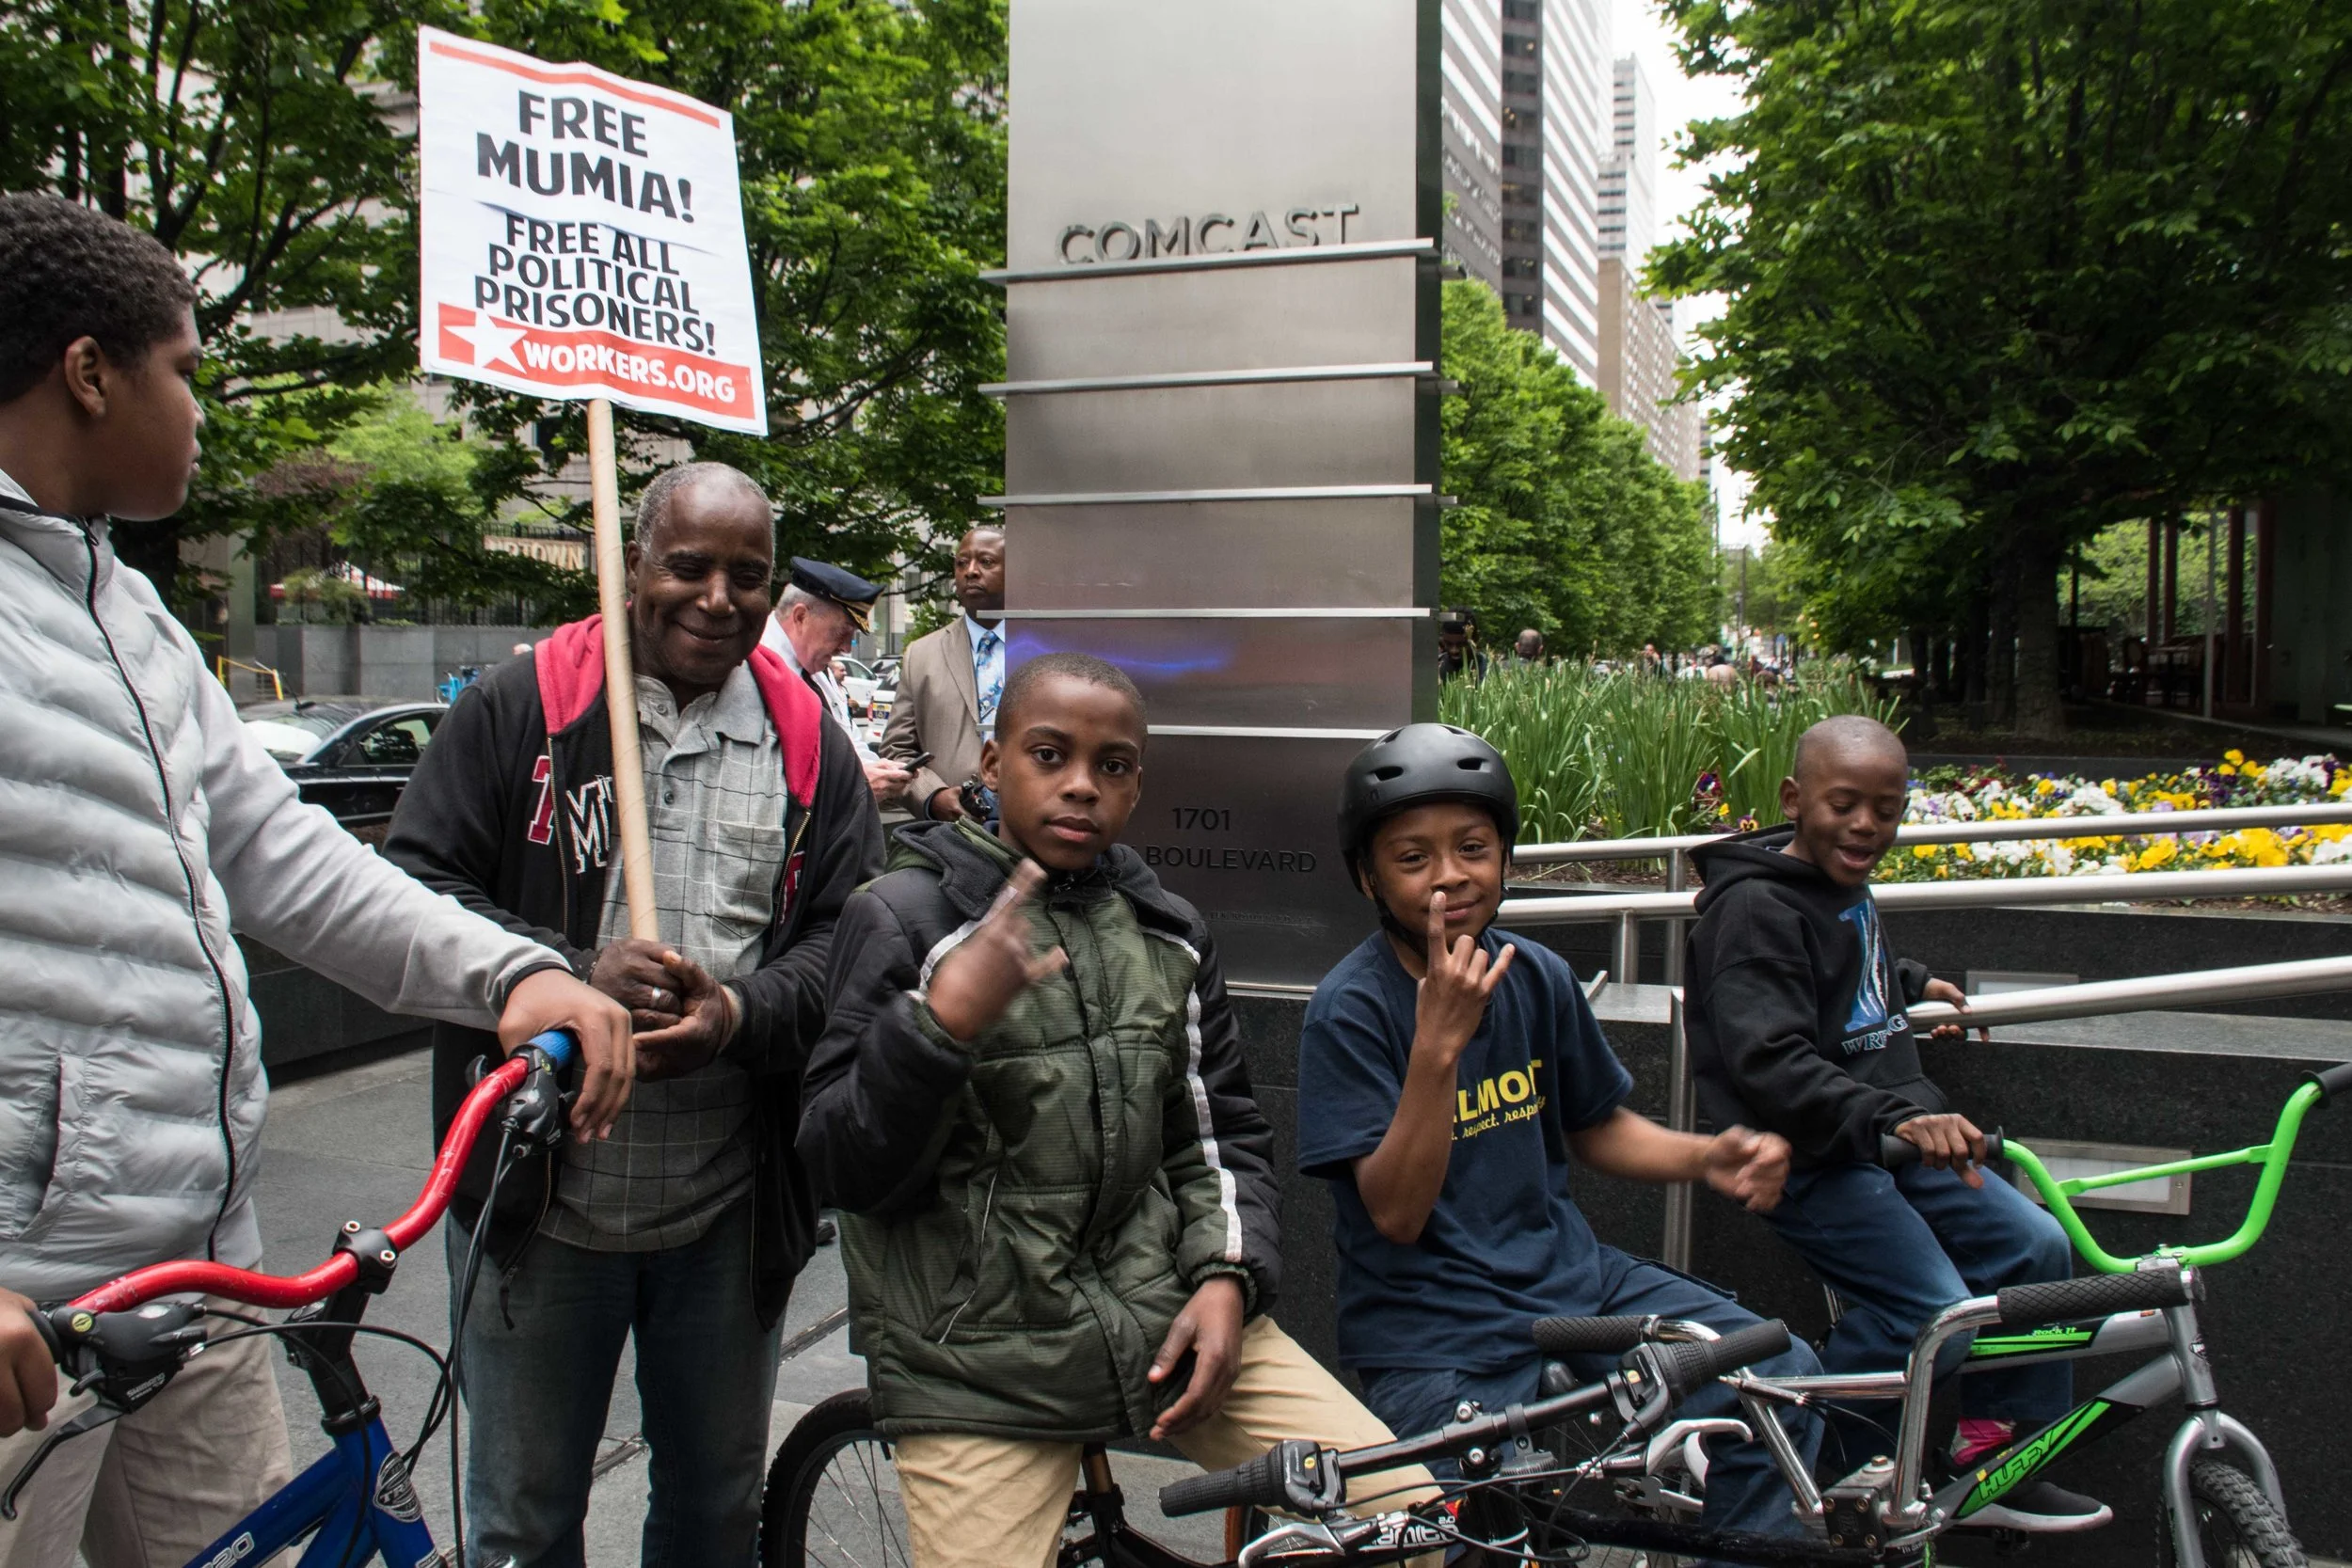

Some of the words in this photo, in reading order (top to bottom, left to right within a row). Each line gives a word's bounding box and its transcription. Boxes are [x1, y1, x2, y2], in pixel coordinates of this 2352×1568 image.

[518, 89, 648, 158] FREE
[476, 131, 695, 224] MUMIA!
[505, 213, 600, 255] FREE
[612, 230, 680, 276] ALL
[1054, 202, 1359, 265] COMCAST
[488, 243, 700, 316] POLITICAL
[474, 275, 716, 356] PRISONERS!
[522, 339, 736, 404] WORKERS.ORG
[1172, 807, 1231, 832] 1701
[1145, 845, 1317, 874] BOULEVARD
[1978, 1429, 2055, 1501] HUFFY
[200, 1531, 255, 1568] 20
